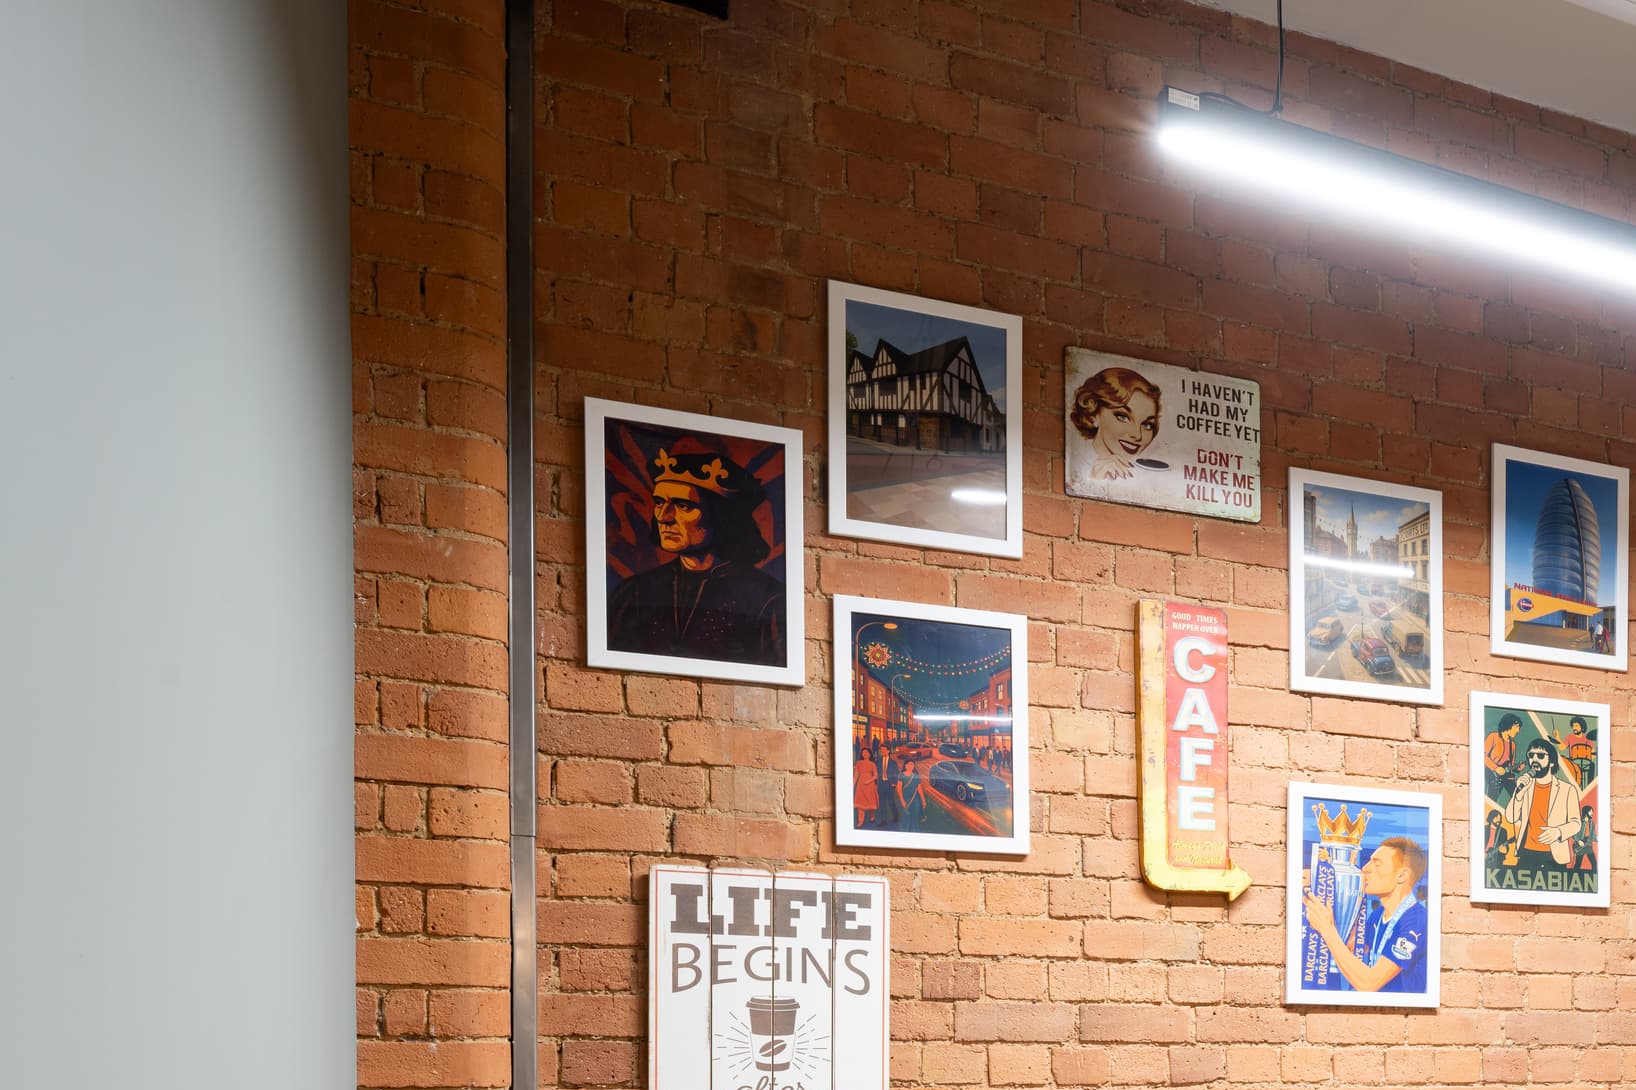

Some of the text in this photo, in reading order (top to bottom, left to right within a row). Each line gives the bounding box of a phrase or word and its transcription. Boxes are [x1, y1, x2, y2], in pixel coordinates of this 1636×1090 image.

[1181, 379, 1255, 406] I HAVEN'T
[1188, 398, 1249, 423] HAD MY
[1176, 414, 1260, 444] COFFEE YET
[1197, 448, 1243, 470] DON'T
[1183, 464, 1256, 491] MAKE ME
[1186, 483, 1253, 508] KILL YOU
[1172, 635, 1219, 832] CAFE
[1486, 867, 1597, 893] KASABIAN
[670, 883, 872, 941] LIFE
[671, 942, 871, 996] BEGINS
[1304, 932, 1319, 982] BARCLAYS
